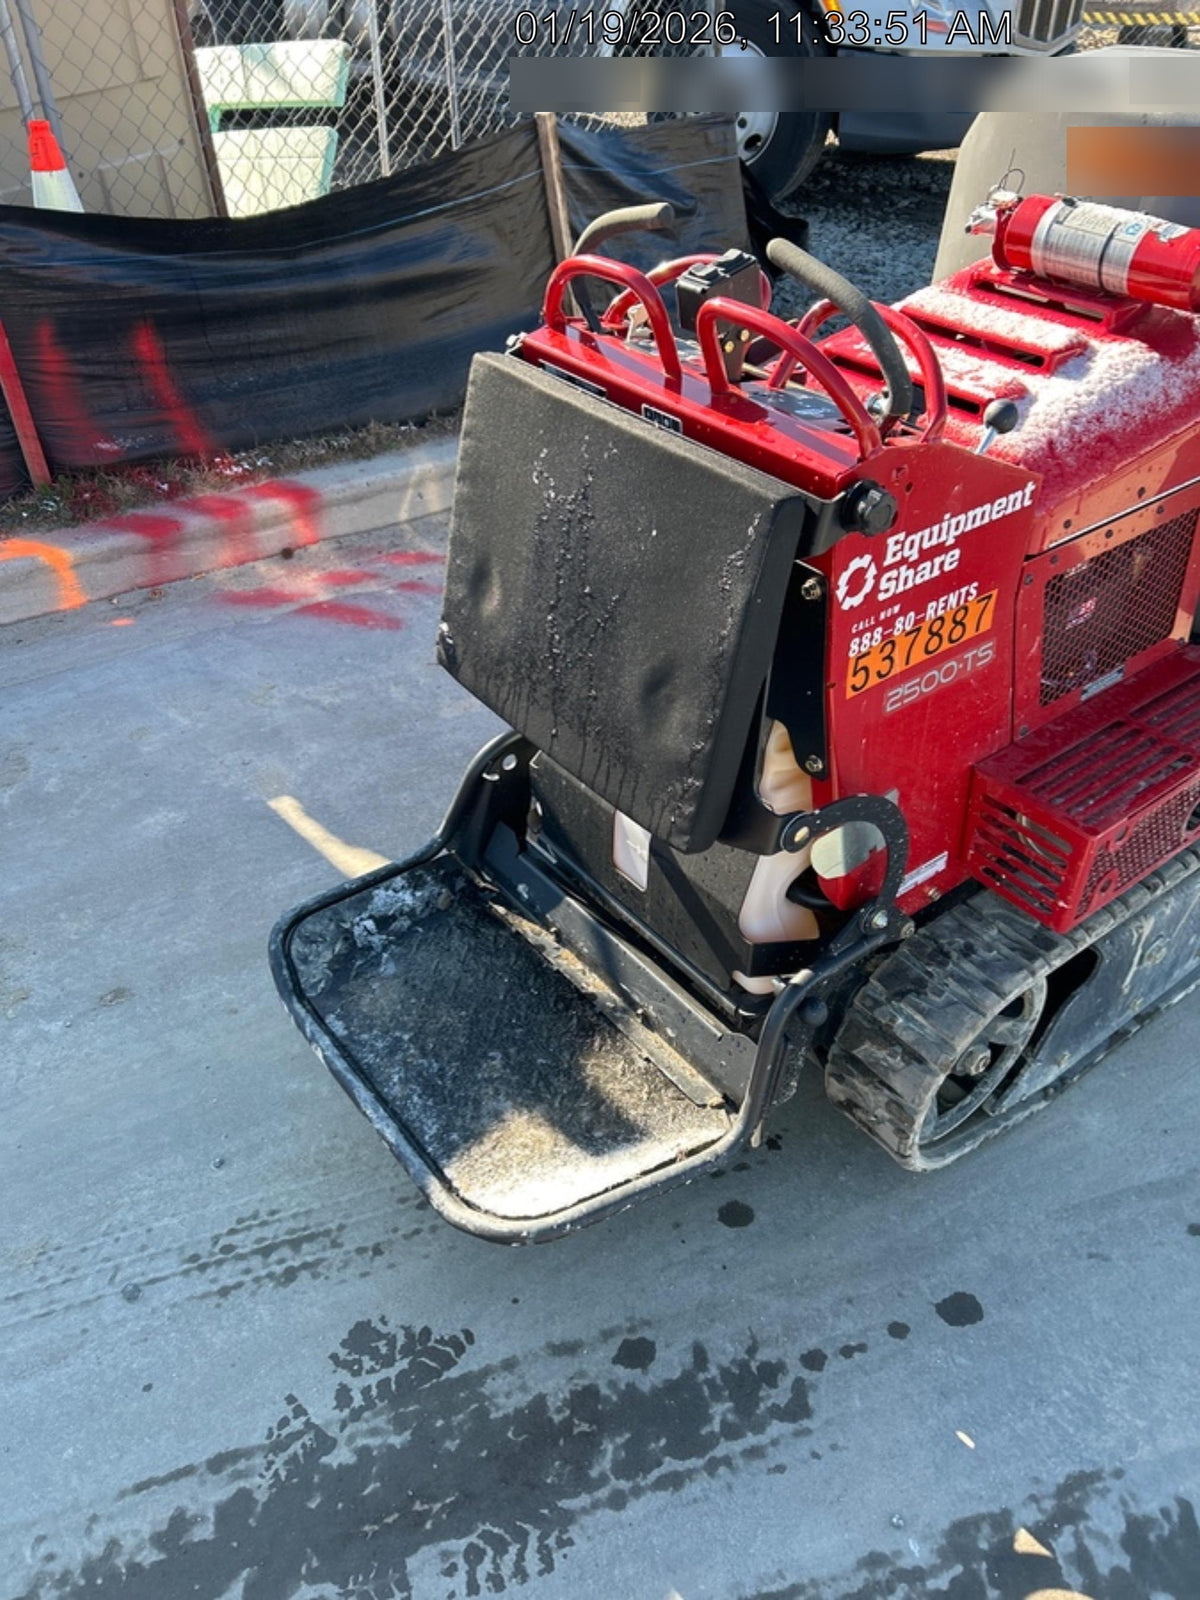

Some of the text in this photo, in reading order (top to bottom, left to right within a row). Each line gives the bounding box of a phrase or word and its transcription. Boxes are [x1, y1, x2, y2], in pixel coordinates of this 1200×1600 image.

[883, 481, 1036, 566] Equipment
[877, 548, 961, 601] Share
[848, 582, 979, 658] 888-80-RENTS
[850, 594, 993, 692] 537887
[851, 616, 876, 634] CALL
